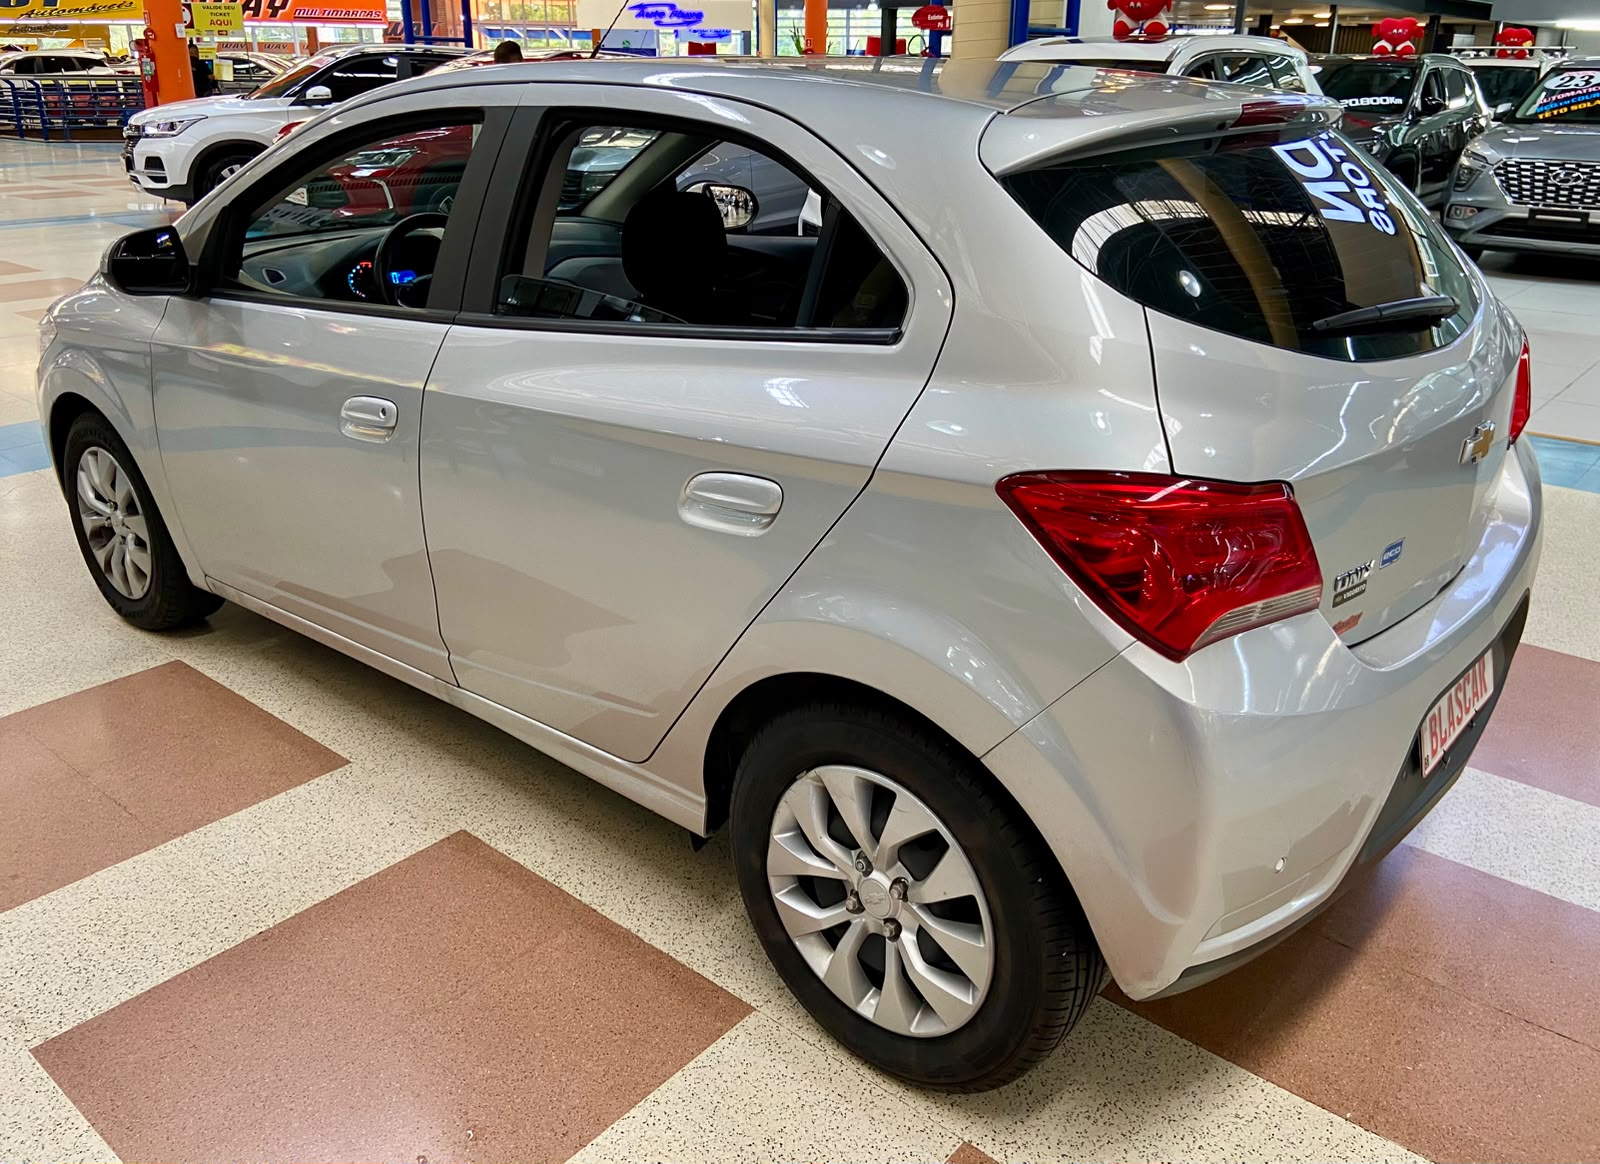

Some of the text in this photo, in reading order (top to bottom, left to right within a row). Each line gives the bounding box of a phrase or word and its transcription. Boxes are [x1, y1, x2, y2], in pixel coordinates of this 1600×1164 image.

[294, 8, 382, 18] MULTIMARCAS
[1555, 75, 1595, 88] 23
[1538, 107, 1568, 119] TETO
[1429, 656, 1488, 759] BLASCAR
